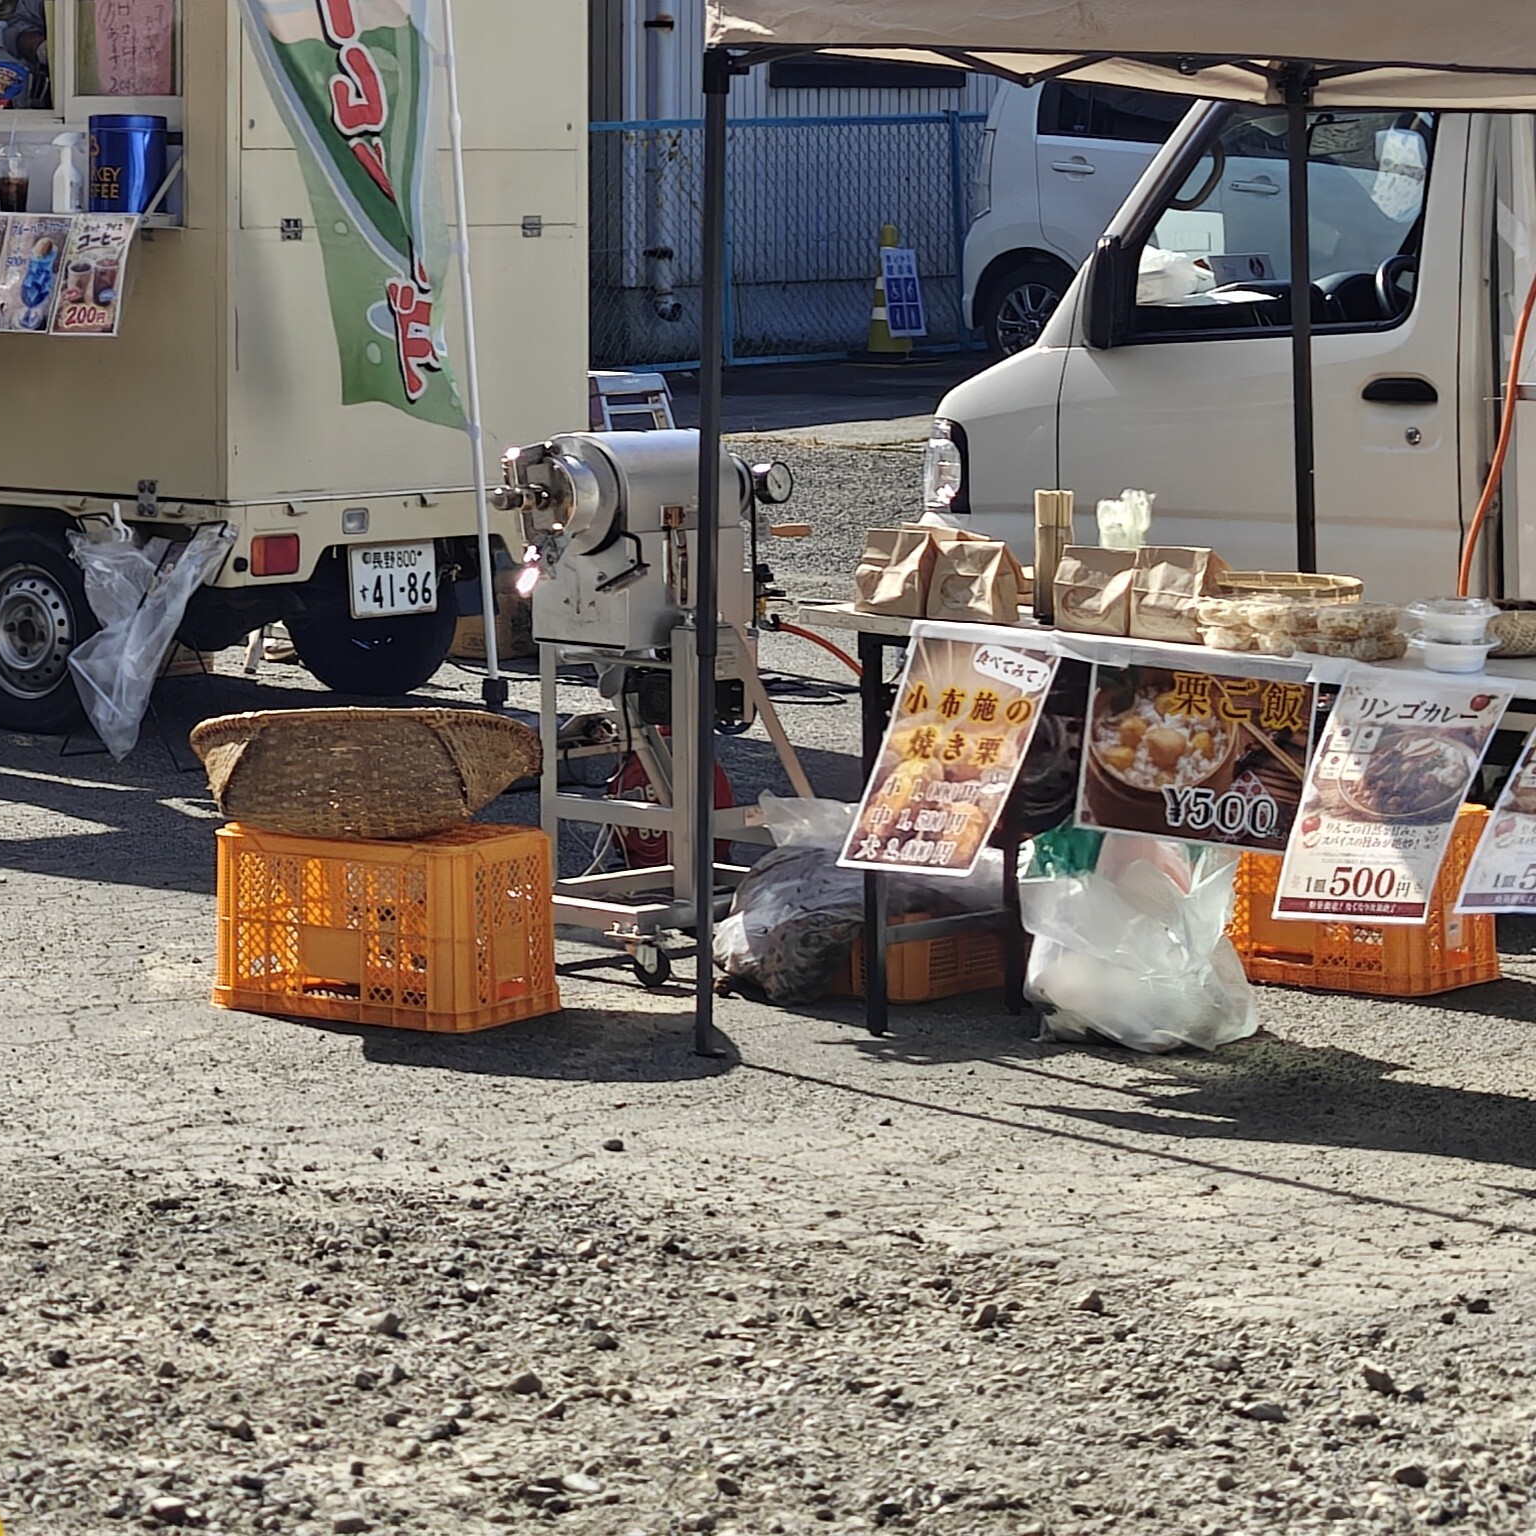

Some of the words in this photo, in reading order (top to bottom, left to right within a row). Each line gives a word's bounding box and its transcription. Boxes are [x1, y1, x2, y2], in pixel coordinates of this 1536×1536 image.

[77, 231, 123, 250] コーヒー
[65, 305, 106, 326] 200円
[372, 551, 395, 569] 長野
[905, 685, 1032, 724] 小布施の
[1169, 672, 1306, 731] 栗ご飯
[1360, 697, 1479, 724] リンゴカレー
[907, 729, 1004, 765] 焼き栗
[1162, 784, 1278, 838] ¥500
